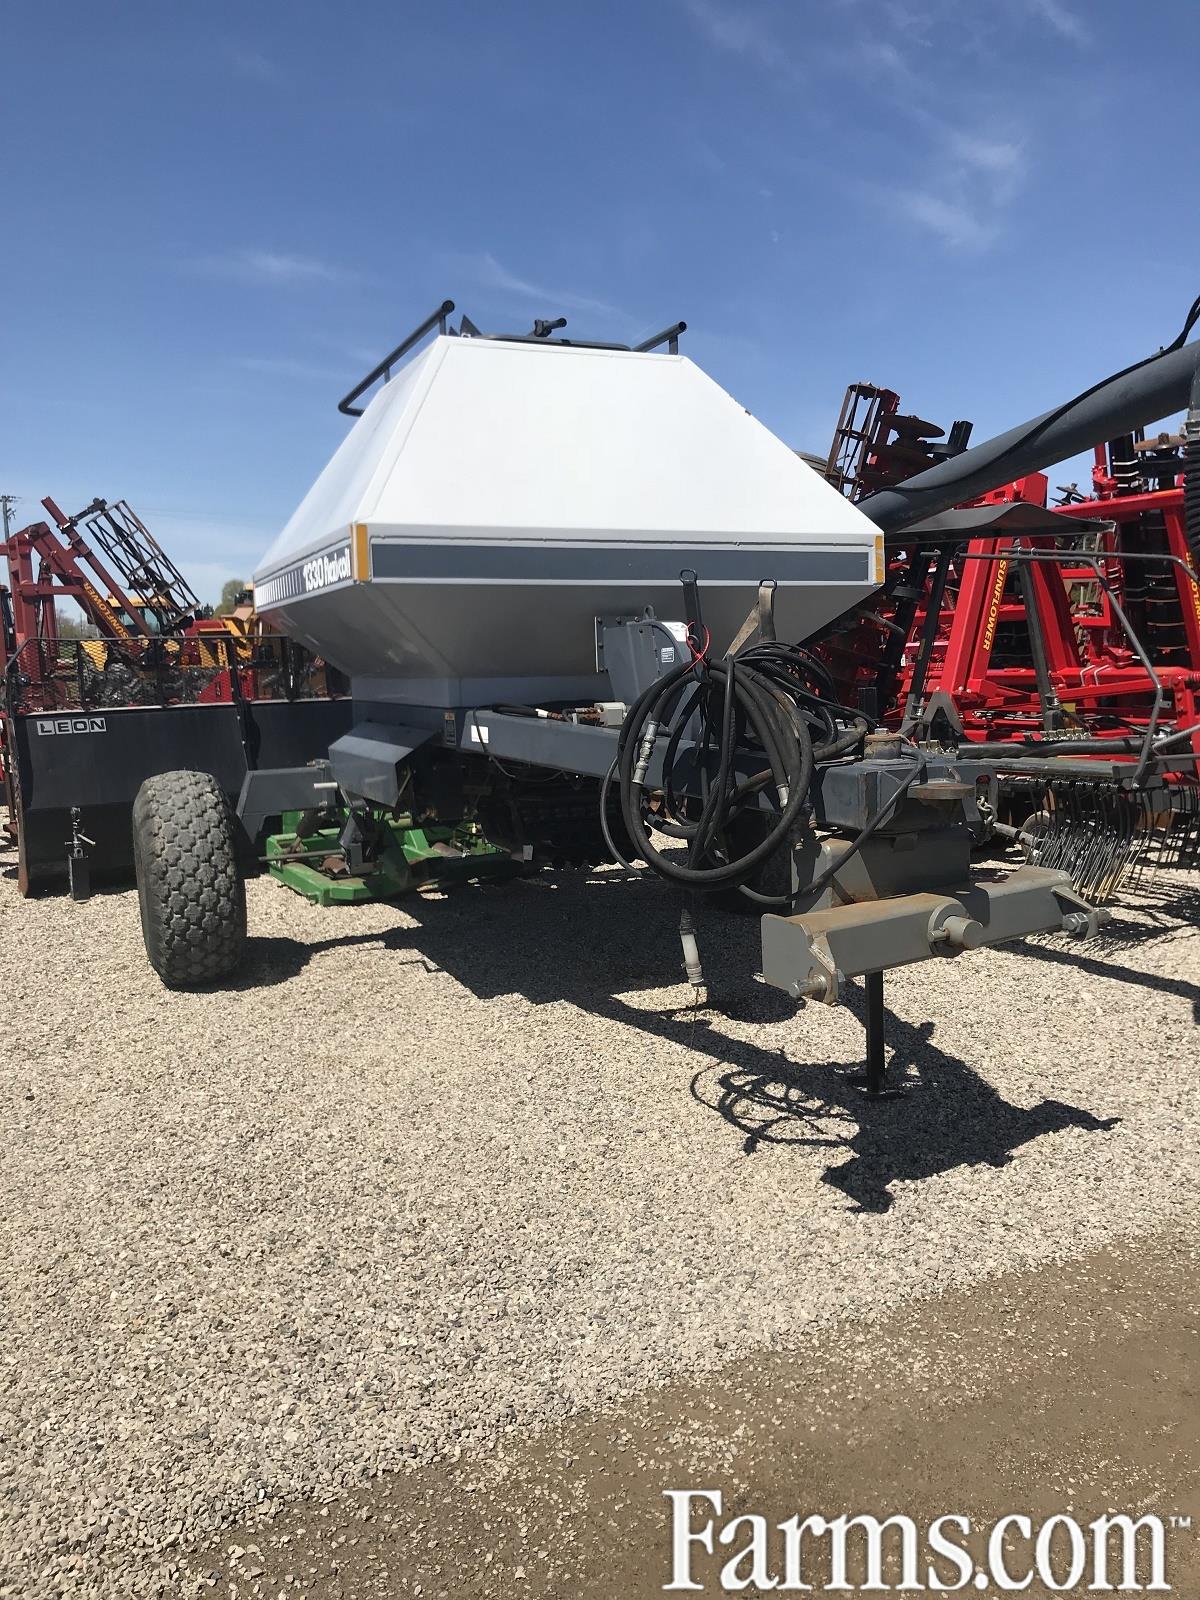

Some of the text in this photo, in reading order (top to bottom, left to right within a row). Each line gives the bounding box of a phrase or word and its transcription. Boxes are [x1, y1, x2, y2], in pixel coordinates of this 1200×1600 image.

[303, 557, 324, 593] 1330
[83, 582, 129, 639] SUNFLOWER
[983, 559, 1007, 650] SUNFLOWER
[38, 718, 106, 735] LEON
